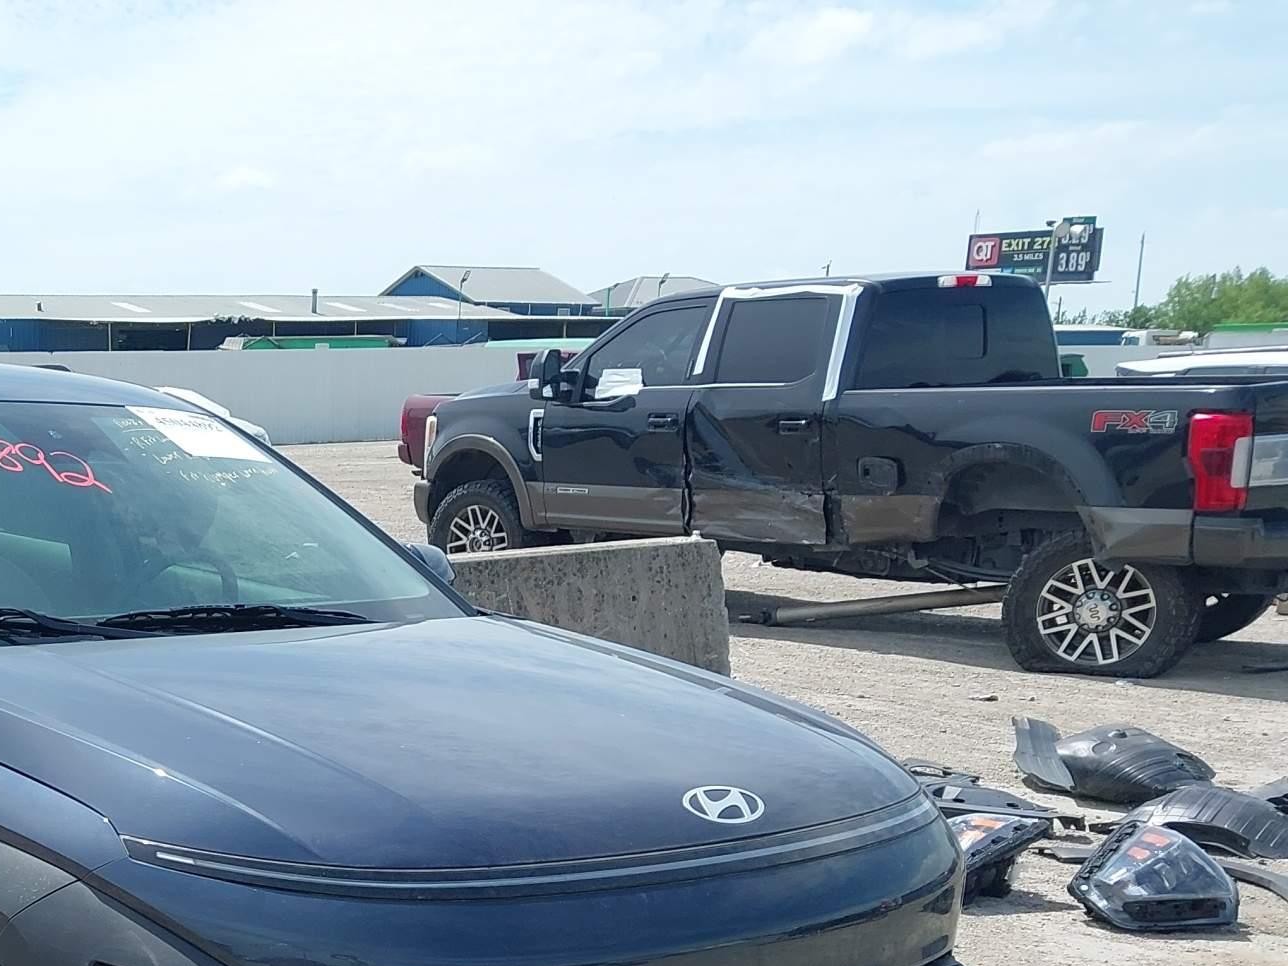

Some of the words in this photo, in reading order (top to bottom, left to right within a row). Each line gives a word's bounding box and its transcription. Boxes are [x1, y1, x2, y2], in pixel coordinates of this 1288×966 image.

[973, 241, 996, 262] QT
[1001, 238, 1031, 251] EXIT
[1024, 252, 1044, 260] MILES
[1091, 410, 1178, 432] FX4
